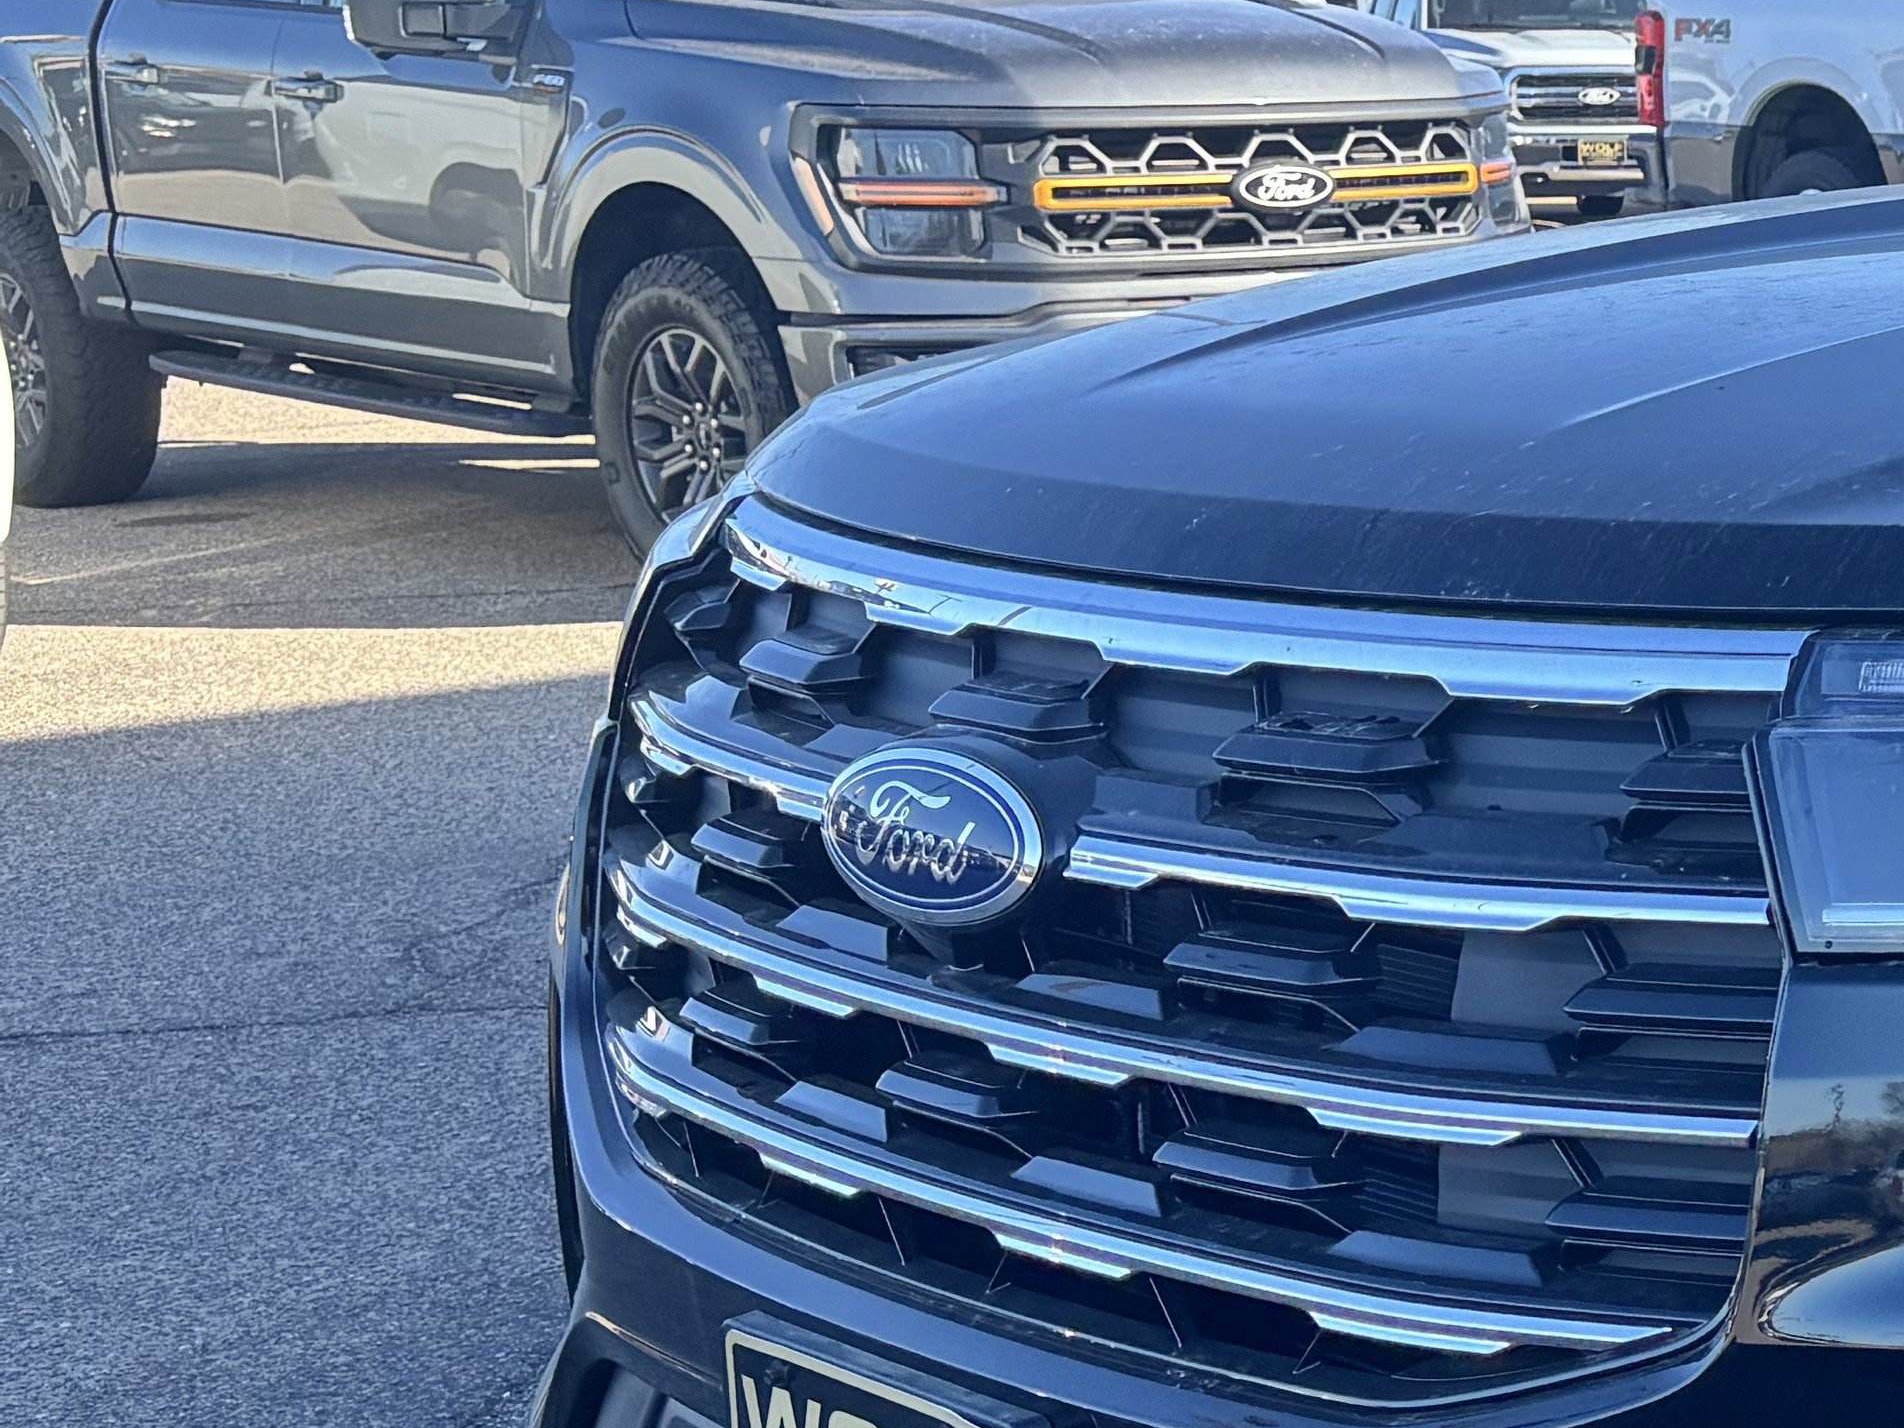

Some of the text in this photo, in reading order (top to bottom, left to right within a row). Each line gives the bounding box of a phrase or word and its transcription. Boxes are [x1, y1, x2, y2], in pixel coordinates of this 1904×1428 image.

[1674, 18, 1732, 42] FX4
[1256, 171, 1317, 202] Ford
[856, 779, 977, 886] Ford
